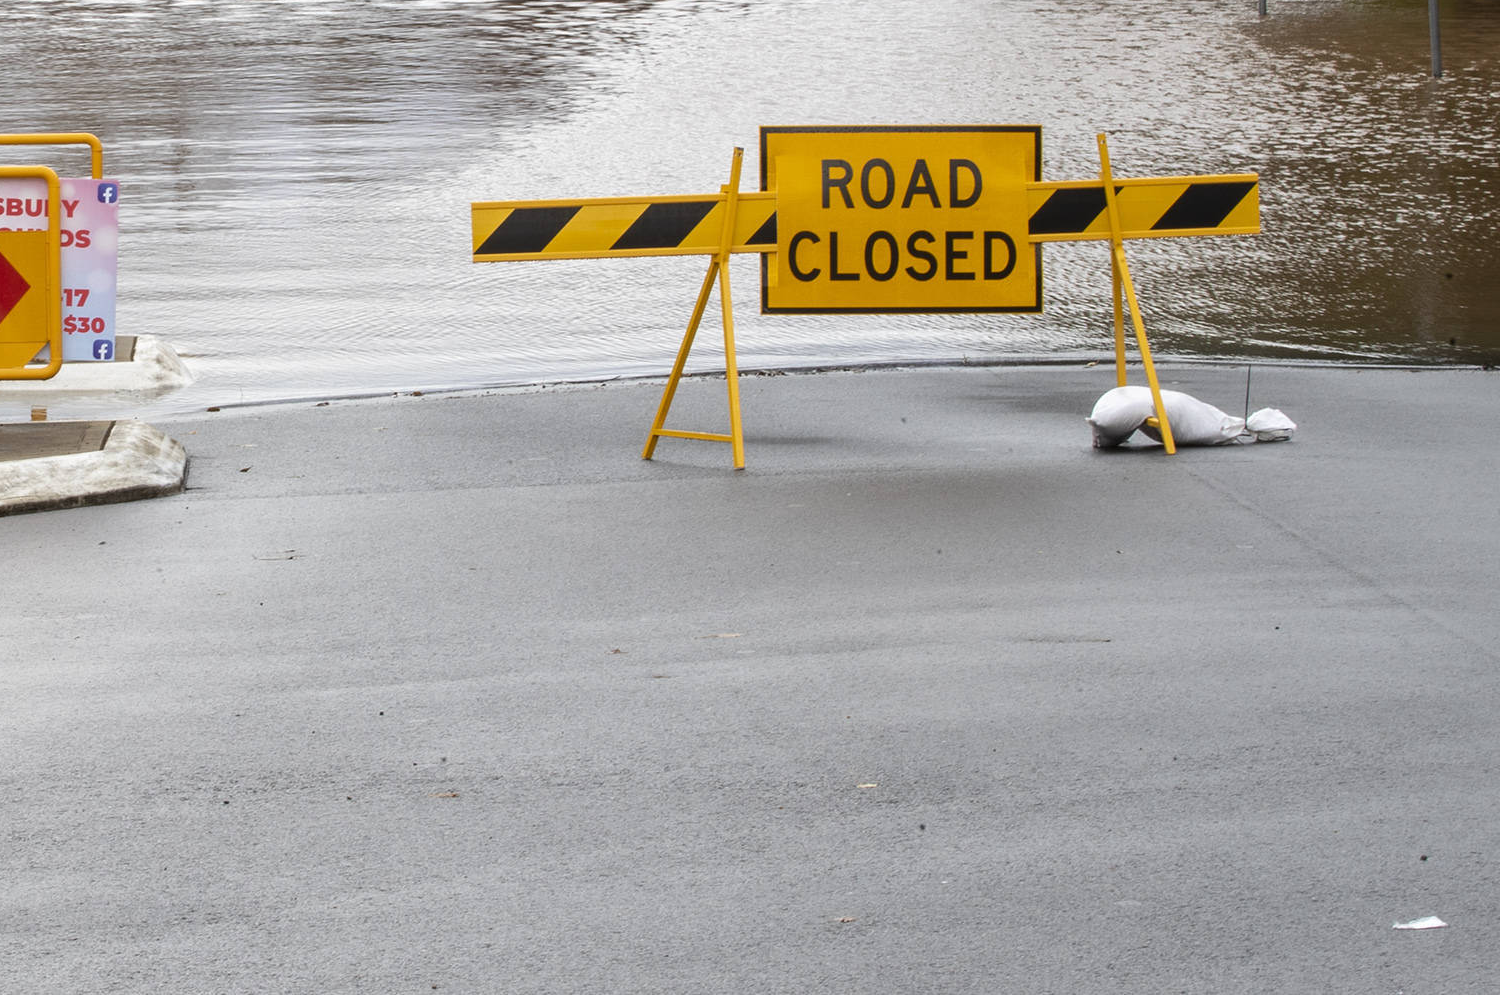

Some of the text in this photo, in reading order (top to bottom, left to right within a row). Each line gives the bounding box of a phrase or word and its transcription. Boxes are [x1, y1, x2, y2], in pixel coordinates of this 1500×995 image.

[821, 158, 983, 209] ROAD
[788, 230, 1017, 282] CLOSED
[63, 314, 106, 335] $30
